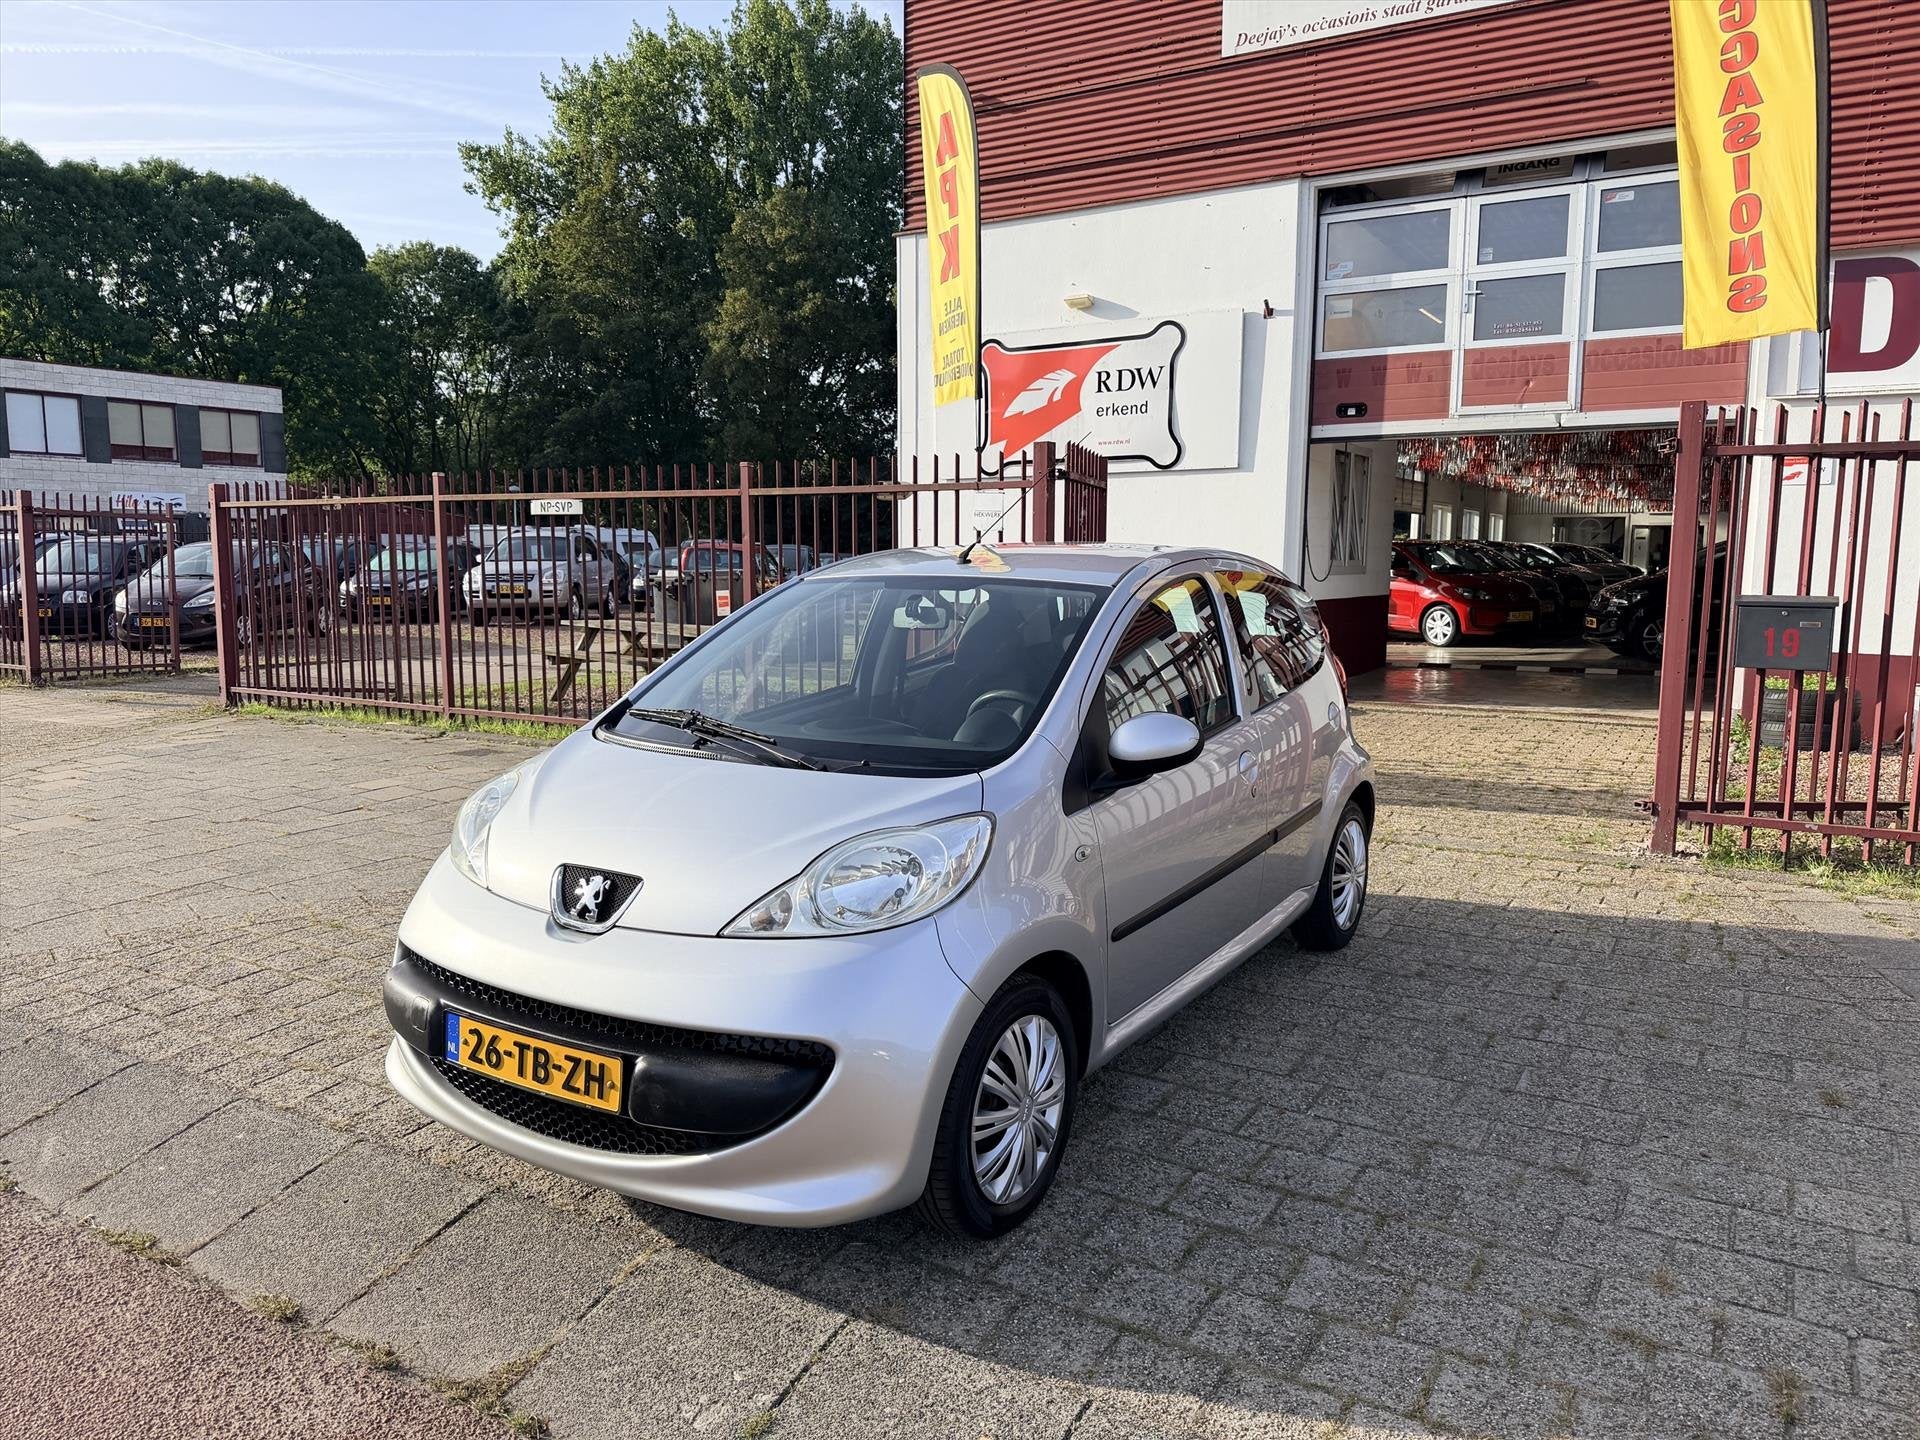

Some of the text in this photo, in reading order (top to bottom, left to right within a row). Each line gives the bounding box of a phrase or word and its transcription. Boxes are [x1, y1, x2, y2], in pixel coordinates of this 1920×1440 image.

[1235, 24, 1298, 48] Deejay's
[1302, 10, 1377, 35] occasions
[1095, 366, 1166, 394] RDW
[1096, 400, 1149, 417] erkend
[1098, 438, 1131, 446] www.rdw.nl
[540, 501, 573, 513] NP-SVP
[1763, 626, 1800, 658] 19
[447, 1041, 458, 1055] NL
[467, 1028, 606, 1100] 26-TB-ZH
